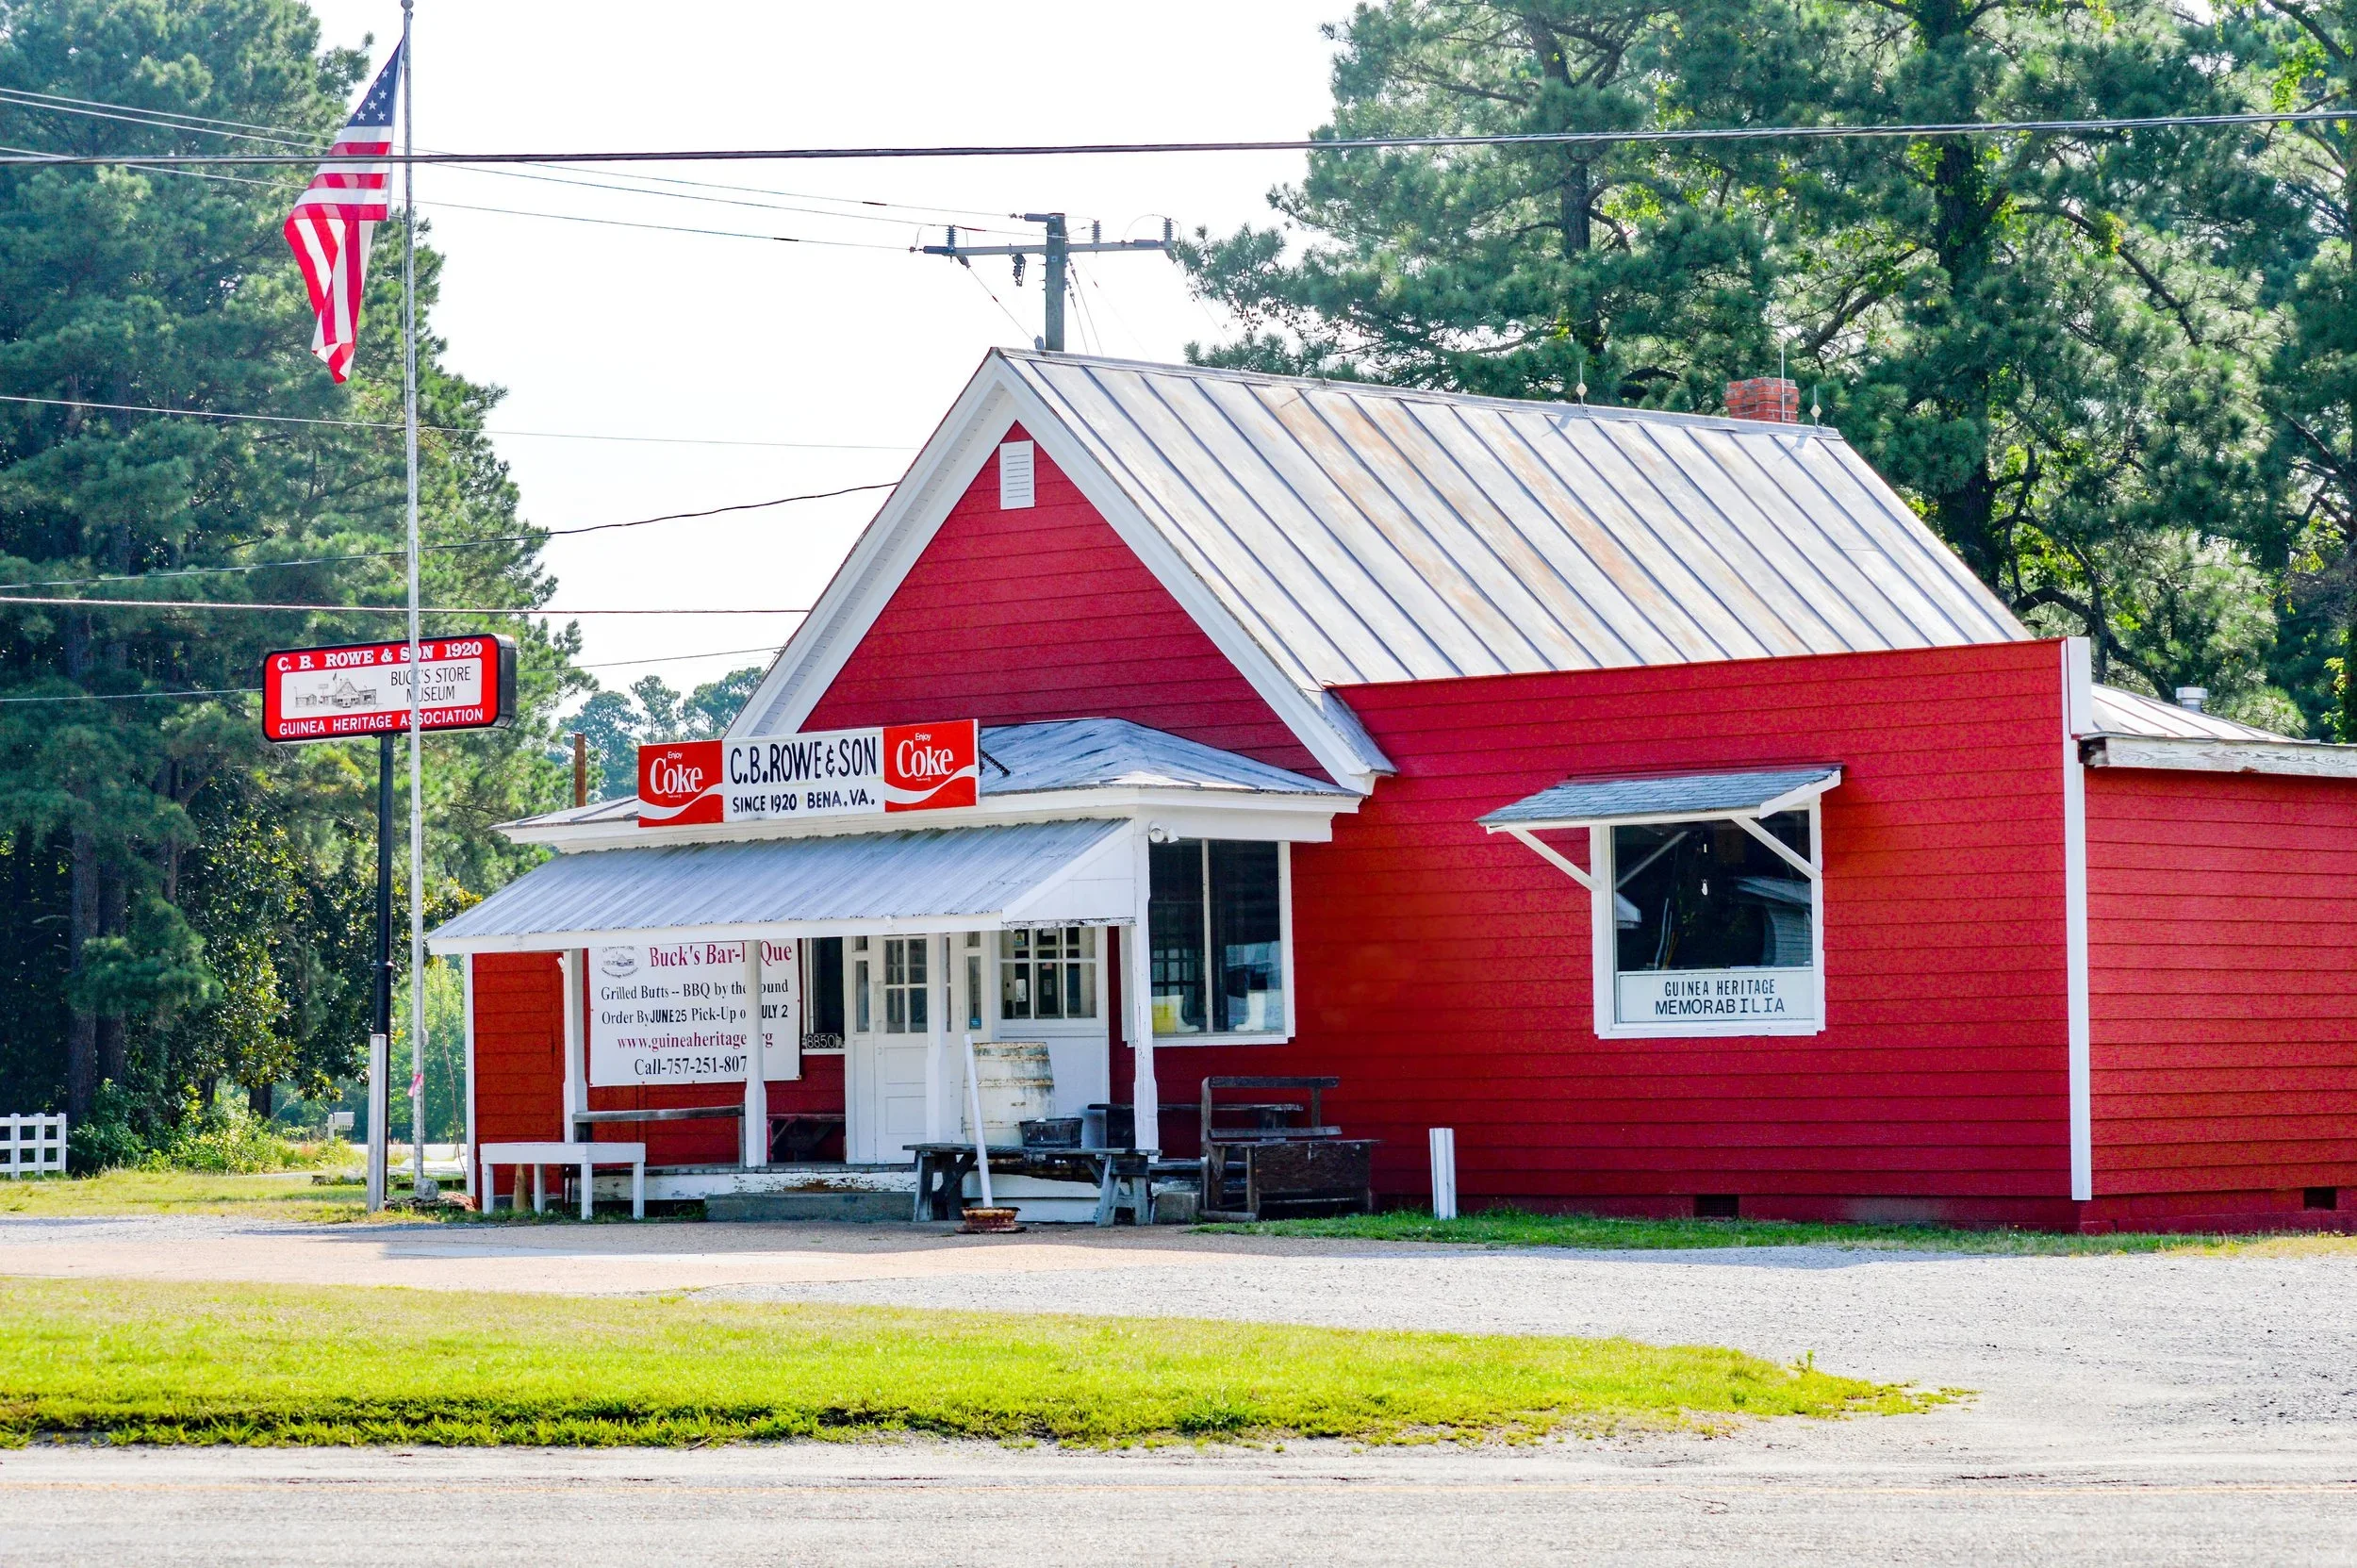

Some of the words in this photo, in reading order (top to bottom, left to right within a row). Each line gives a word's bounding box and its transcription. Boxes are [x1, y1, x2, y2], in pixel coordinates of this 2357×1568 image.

[276, 657, 291, 671] C.
[299, 655, 315, 669] B.
[324, 650, 374, 668] ROWE
[380, 648, 393, 663] &
[444, 641, 483, 658] 1920
[436, 666, 471, 684] STORE
[279, 719, 326, 735] GUINEA
[333, 715, 393, 732] HERITAGE
[915, 733, 931, 741] Enjoy
[668, 751, 684, 760] Enjoy
[896, 739, 954, 779] Coke
[650, 757, 703, 795] Coke
[733, 795, 766, 813] SINCE
[770, 793, 798, 813] 1920
[649, 945, 701, 967] Buck's
[601, 985, 637, 1000] Grilled
[641, 984, 669, 999] Butts
[683, 982, 711, 999] BBQ
[714, 982, 729, 999] by
[761, 979, 789, 993] ound
[1664, 981, 1709, 997] GUINEA
[1716, 979, 1775, 996] HERITAGE
[602, 1011, 634, 1025] Order
[636, 1010, 650, 1027] By
[691, 1006, 736, 1023] Pick-Up
[761, 1004, 778, 1019] ULY
[781, 1004, 788, 1018] 2
[1655, 998, 1785, 1015] MEMORABILIA
[806, 1034, 835, 1048] 8850
